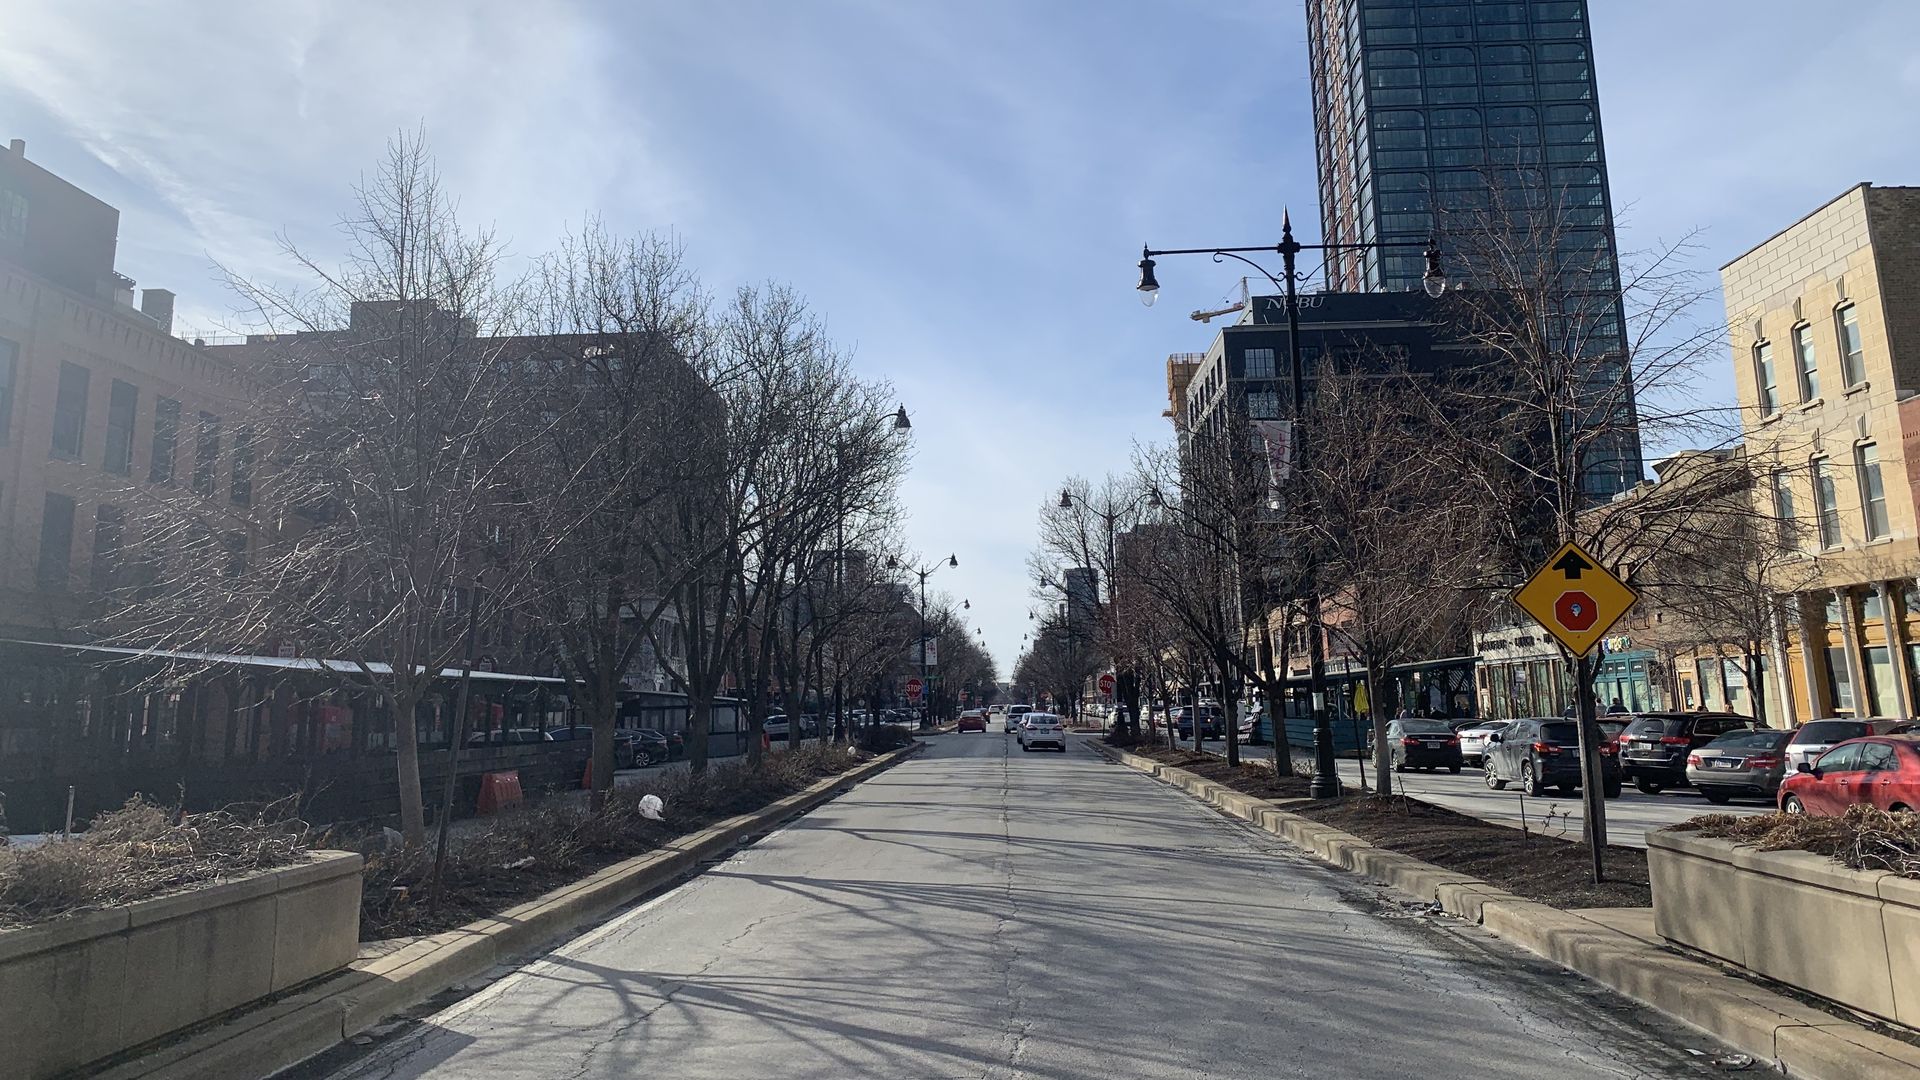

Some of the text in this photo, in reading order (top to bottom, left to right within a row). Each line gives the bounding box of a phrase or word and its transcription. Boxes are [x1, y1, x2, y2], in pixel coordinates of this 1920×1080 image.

[1266, 296, 1325, 310] NBU
[906, 684, 921, 692] STOP
[1099, 680, 1113, 688] STO
